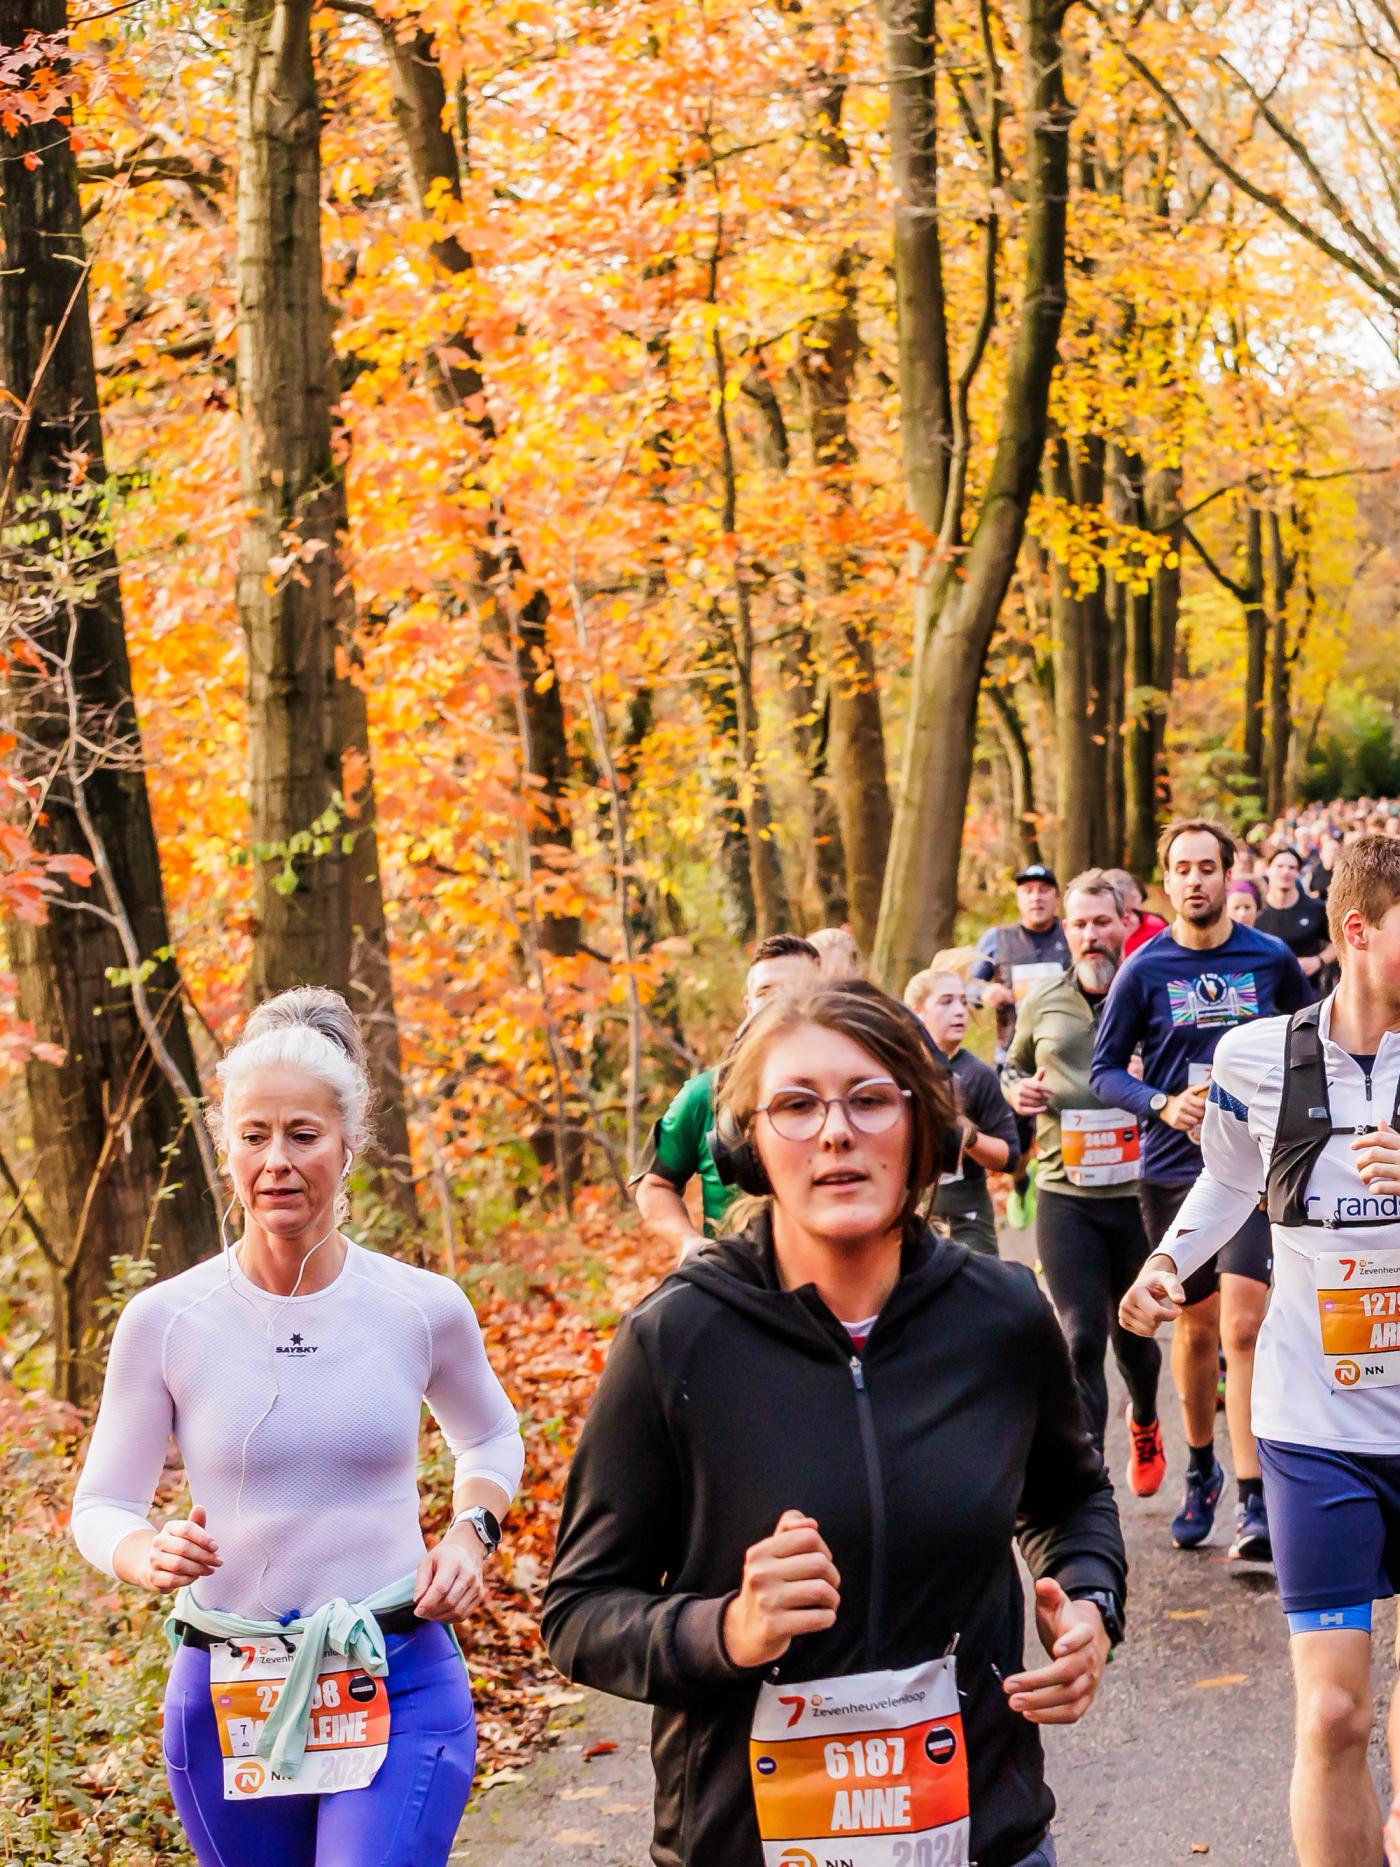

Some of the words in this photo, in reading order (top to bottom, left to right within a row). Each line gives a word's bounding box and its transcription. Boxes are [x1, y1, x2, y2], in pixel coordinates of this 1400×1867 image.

[1339, 1259, 1356, 1282] 7
[276, 1346, 318, 1354] SAYSKY
[1365, 1366, 1385, 1375] NN
[257, 1679, 341, 1713] 2708
[778, 1695, 806, 1728] 7
[812, 1691, 926, 1717] Zevenheuvelenloop
[823, 1737, 905, 1780] 6187
[831, 1786, 912, 1831] ANNE
[892, 1827, 967, 1867] 2024
